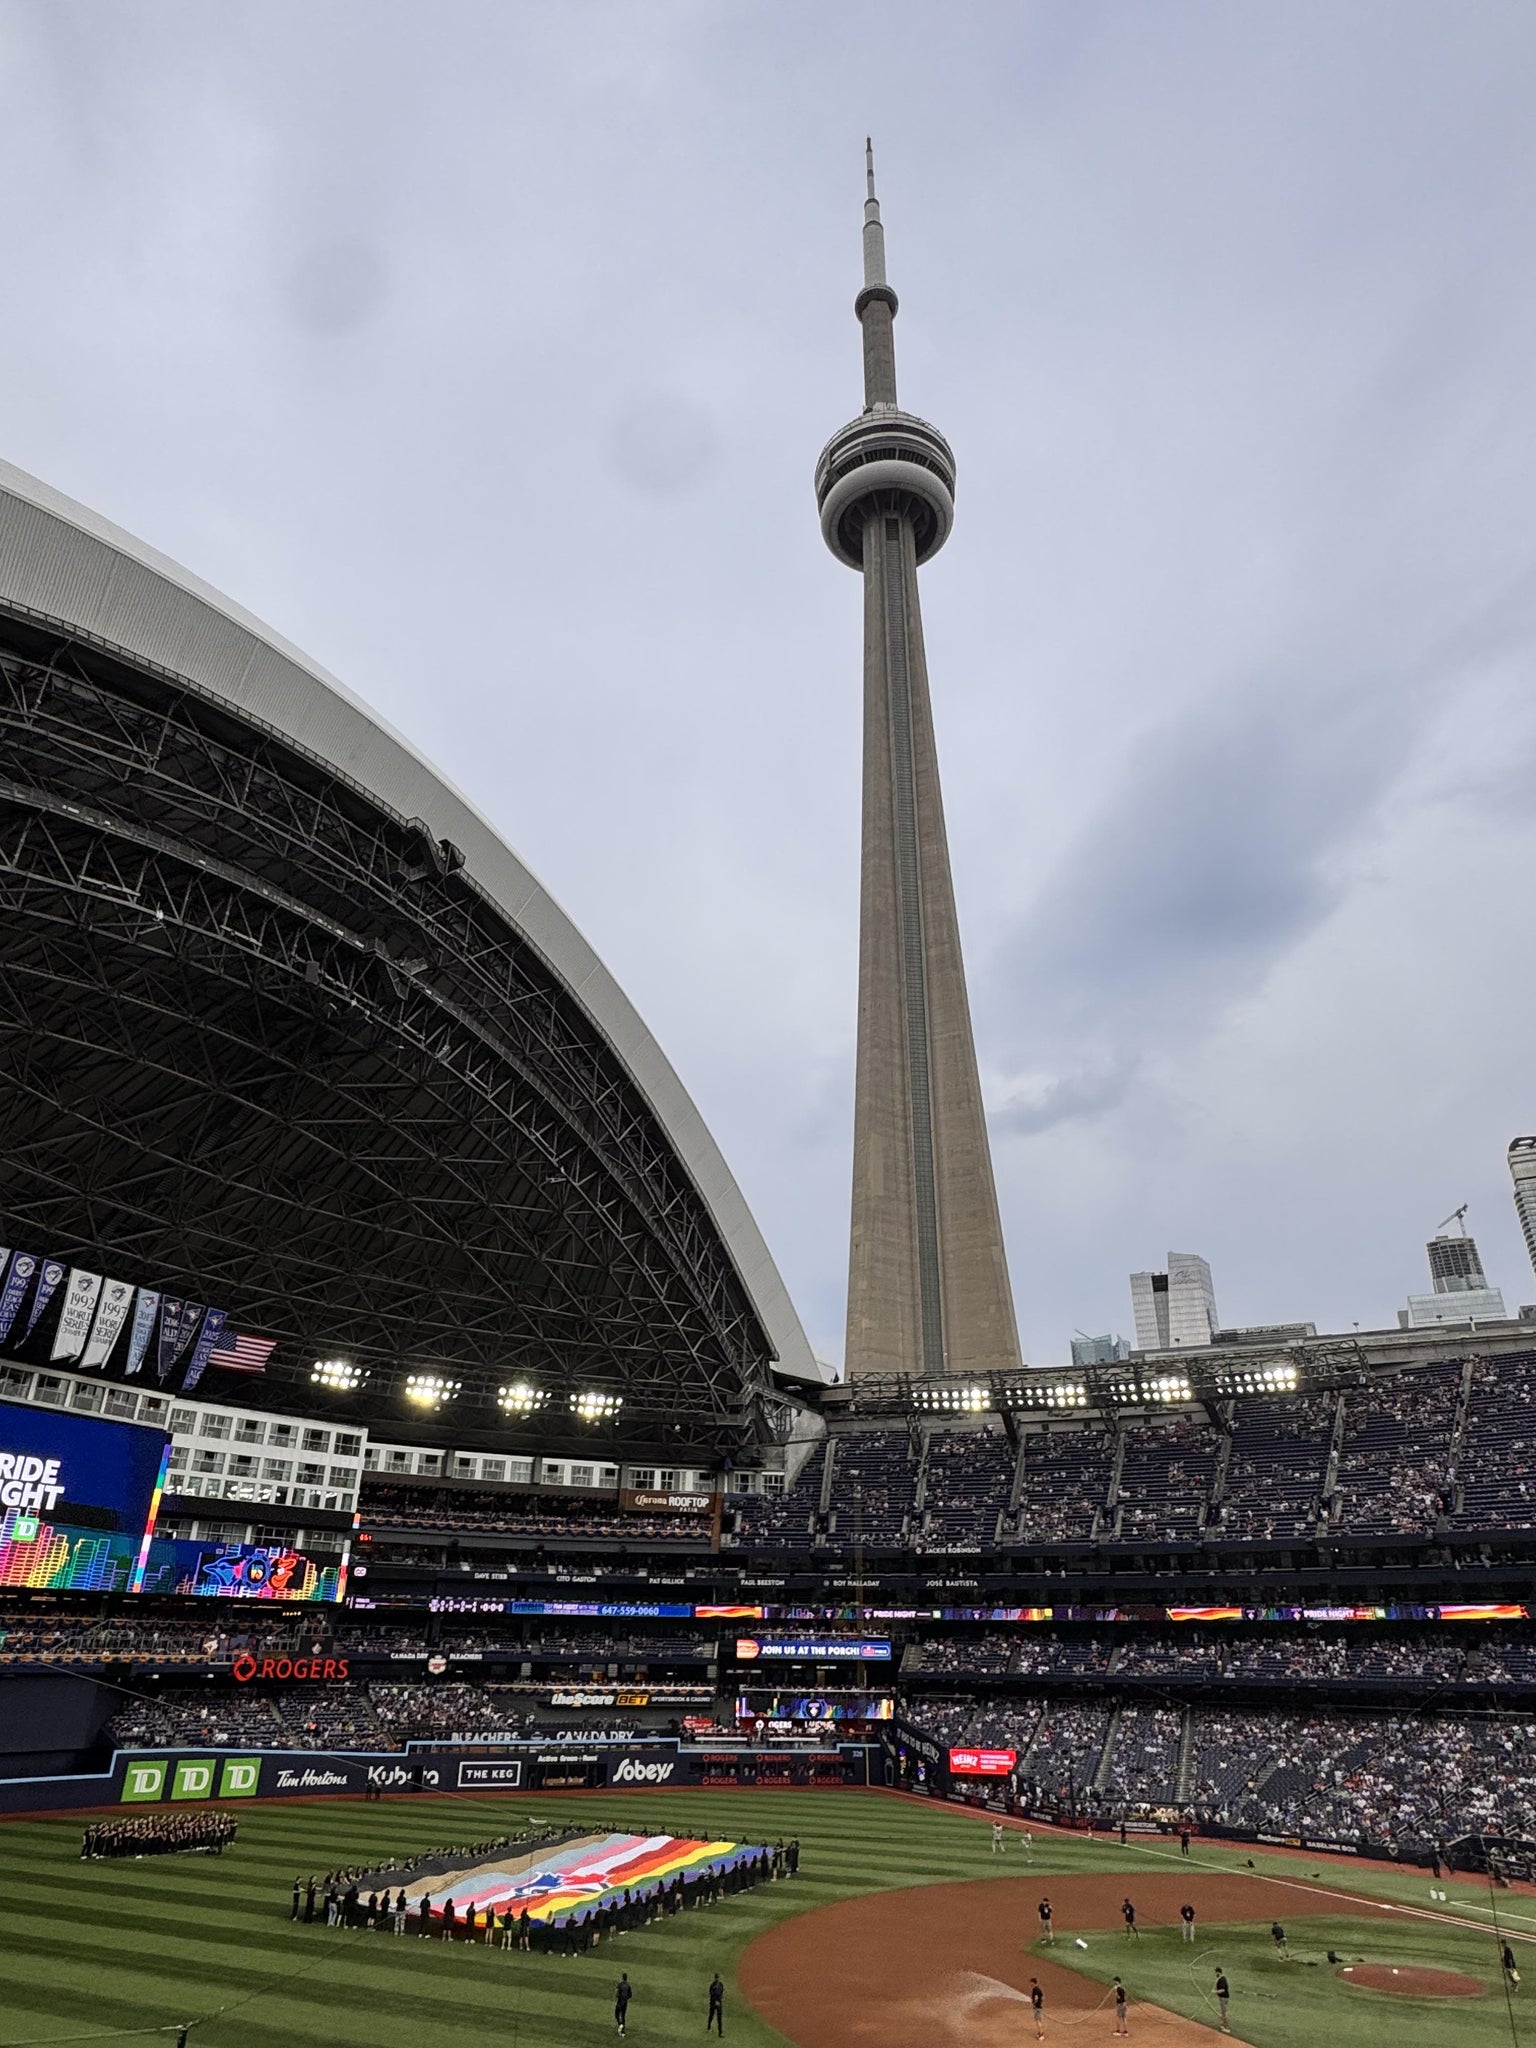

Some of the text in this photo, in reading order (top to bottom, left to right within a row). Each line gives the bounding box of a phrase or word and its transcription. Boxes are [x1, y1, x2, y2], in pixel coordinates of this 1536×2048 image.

[70, 1293, 95, 1310] 1992
[0, 1453, 61, 1484] RIDE
[0, 1480, 65, 1510] GHT
[635, 1494, 709, 1507] Corona ROOFTOP
[17, 1521, 34, 1536] TD
[926, 1579, 943, 1587] JOSÉ
[601, 1606, 659, 1616] 647-559-0060
[1303, 1610, 1355, 1618] PRIDE NIGHT
[761, 1646, 782, 1655] JOIN
[784, 1646, 796, 1655] US
[797, 1646, 810, 1655] AT
[811, 1646, 827, 1655] THE
[828, 1646, 860, 1655] PORCH!
[262, 1658, 349, 1679] ROGERS
[551, 1692, 614, 1706] theScore
[618, 1695, 648, 1704] BET
[952, 1754, 979, 1767] HEINZ
[227, 1765, 256, 1789] TD
[277, 1768, 348, 1788] Tim Hortons
[466, 1769, 514, 1779] THE KEG
[612, 1758, 674, 1783] Sobeys
[131, 1768, 161, 1793] TD
[180, 1767, 210, 1792] TD
